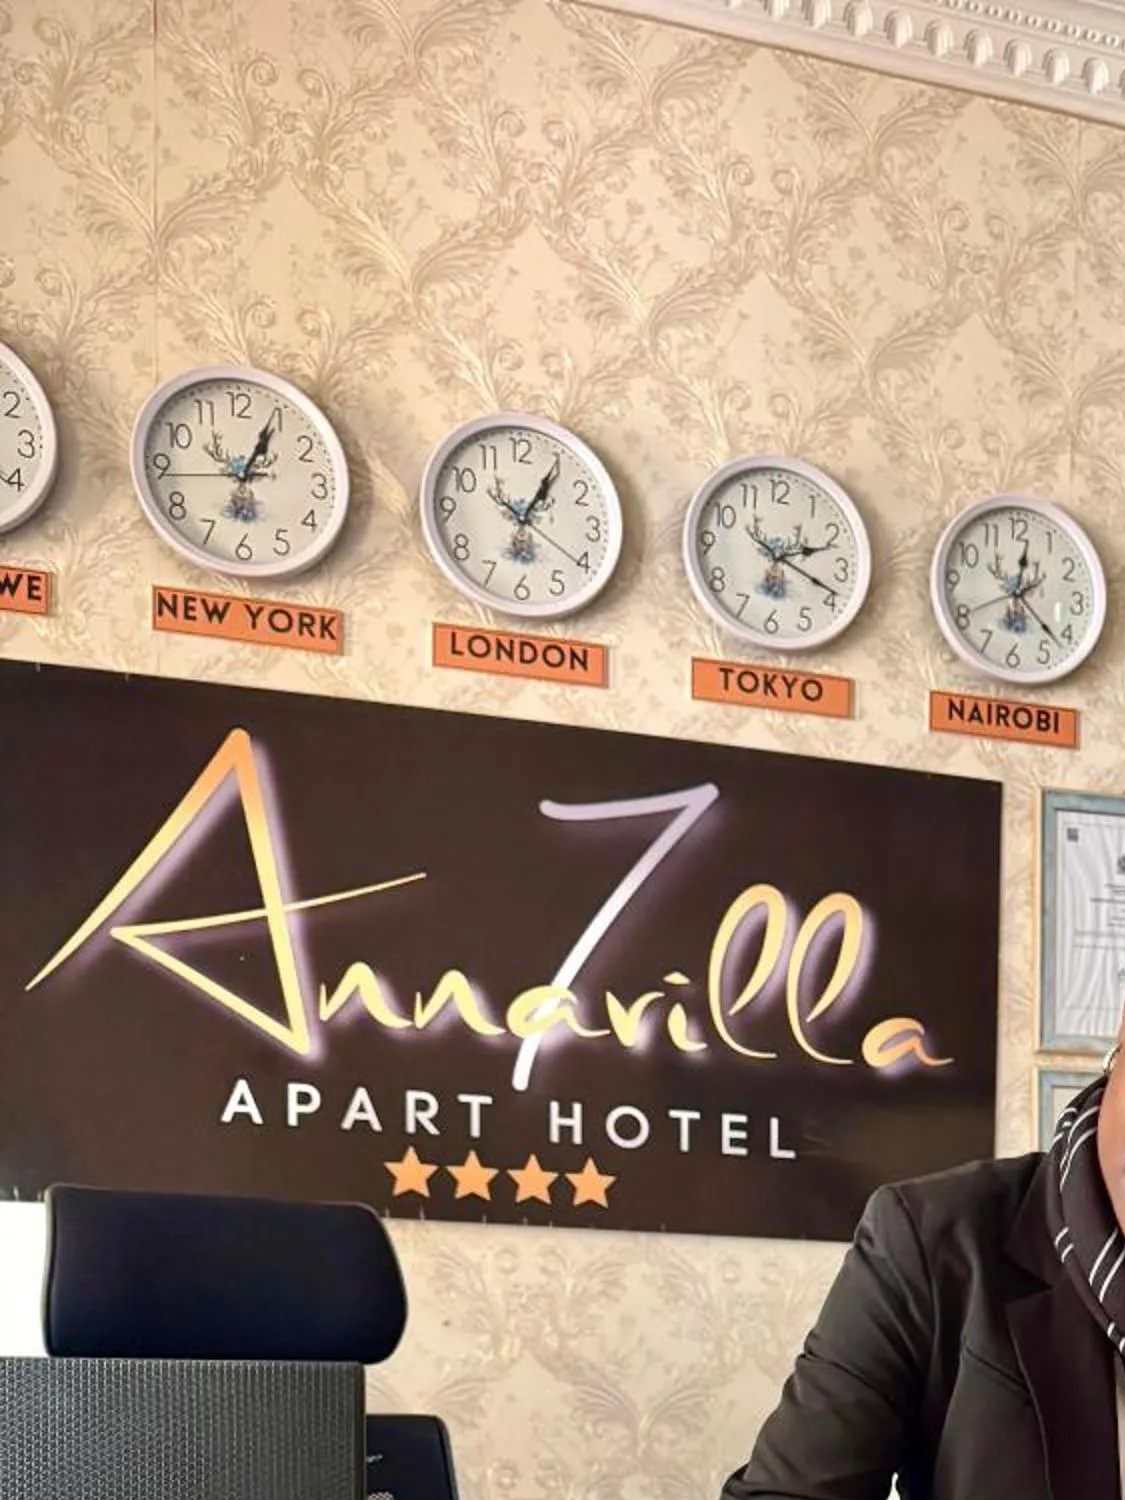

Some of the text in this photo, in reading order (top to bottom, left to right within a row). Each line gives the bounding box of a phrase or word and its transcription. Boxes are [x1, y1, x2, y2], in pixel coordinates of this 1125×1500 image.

[3, 391, 21, 419] 2
[195, 399, 214, 425] 11
[225, 392, 252, 419] 12
[18, 429, 35, 459] 3
[166, 422, 192, 449] 10
[297, 435, 314, 462] 2
[480, 444, 497, 470] 11
[510, 438, 533, 464] 12
[7, 468, 24, 492] 4
[153, 454, 171, 480] 9
[452, 466, 476, 493] 10
[311, 473, 328, 500] 3
[573, 480, 589, 506] 2
[742, 484, 757, 509] 11
[770, 480, 789, 505] 12
[169, 492, 187, 520] 8
[440, 496, 456, 522] 9
[714, 503, 736, 528] 10
[809, 495, 815, 518] 1
[200, 519, 216, 544] 7
[301, 509, 318, 532] 4
[586, 516, 600, 542] 3
[1009, 517, 1028, 542] 12
[235, 533, 253, 561] 6
[273, 529, 290, 556] 5
[454, 534, 470, 560] 8
[701, 532, 716, 555] 9
[825, 523, 839, 548] 2
[984, 522, 998, 546] 11
[1047, 532, 1053, 554] 1
[576, 551, 590, 574] 4
[959, 541, 978, 568] 10
[483, 560, 497, 588] 7
[710, 567, 725, 592] 8
[834, 558, 849, 582] 3
[947, 570, 960, 591] 9
[1062, 557, 1075, 582] 2
[514, 574, 530, 600] 6
[550, 570, 565, 596] 5
[157, 593, 337, 640] NEW YORK
[737, 593, 750, 618] 7
[956, 604, 970, 630] 8
[1070, 592, 1084, 616] 3
[764, 609, 778, 633] 6
[798, 607, 812, 631] 5
[981, 629, 993, 653] 7
[1061, 624, 1073, 645] 4
[450, 631, 588, 672] LONDON
[1006, 644, 1020, 668] 6
[1037, 640, 1050, 664] 5
[719, 668, 824, 702] TOKYO
[948, 700, 1060, 734] NAIROBI
[220, 1078, 798, 1160] APART HOTEL
